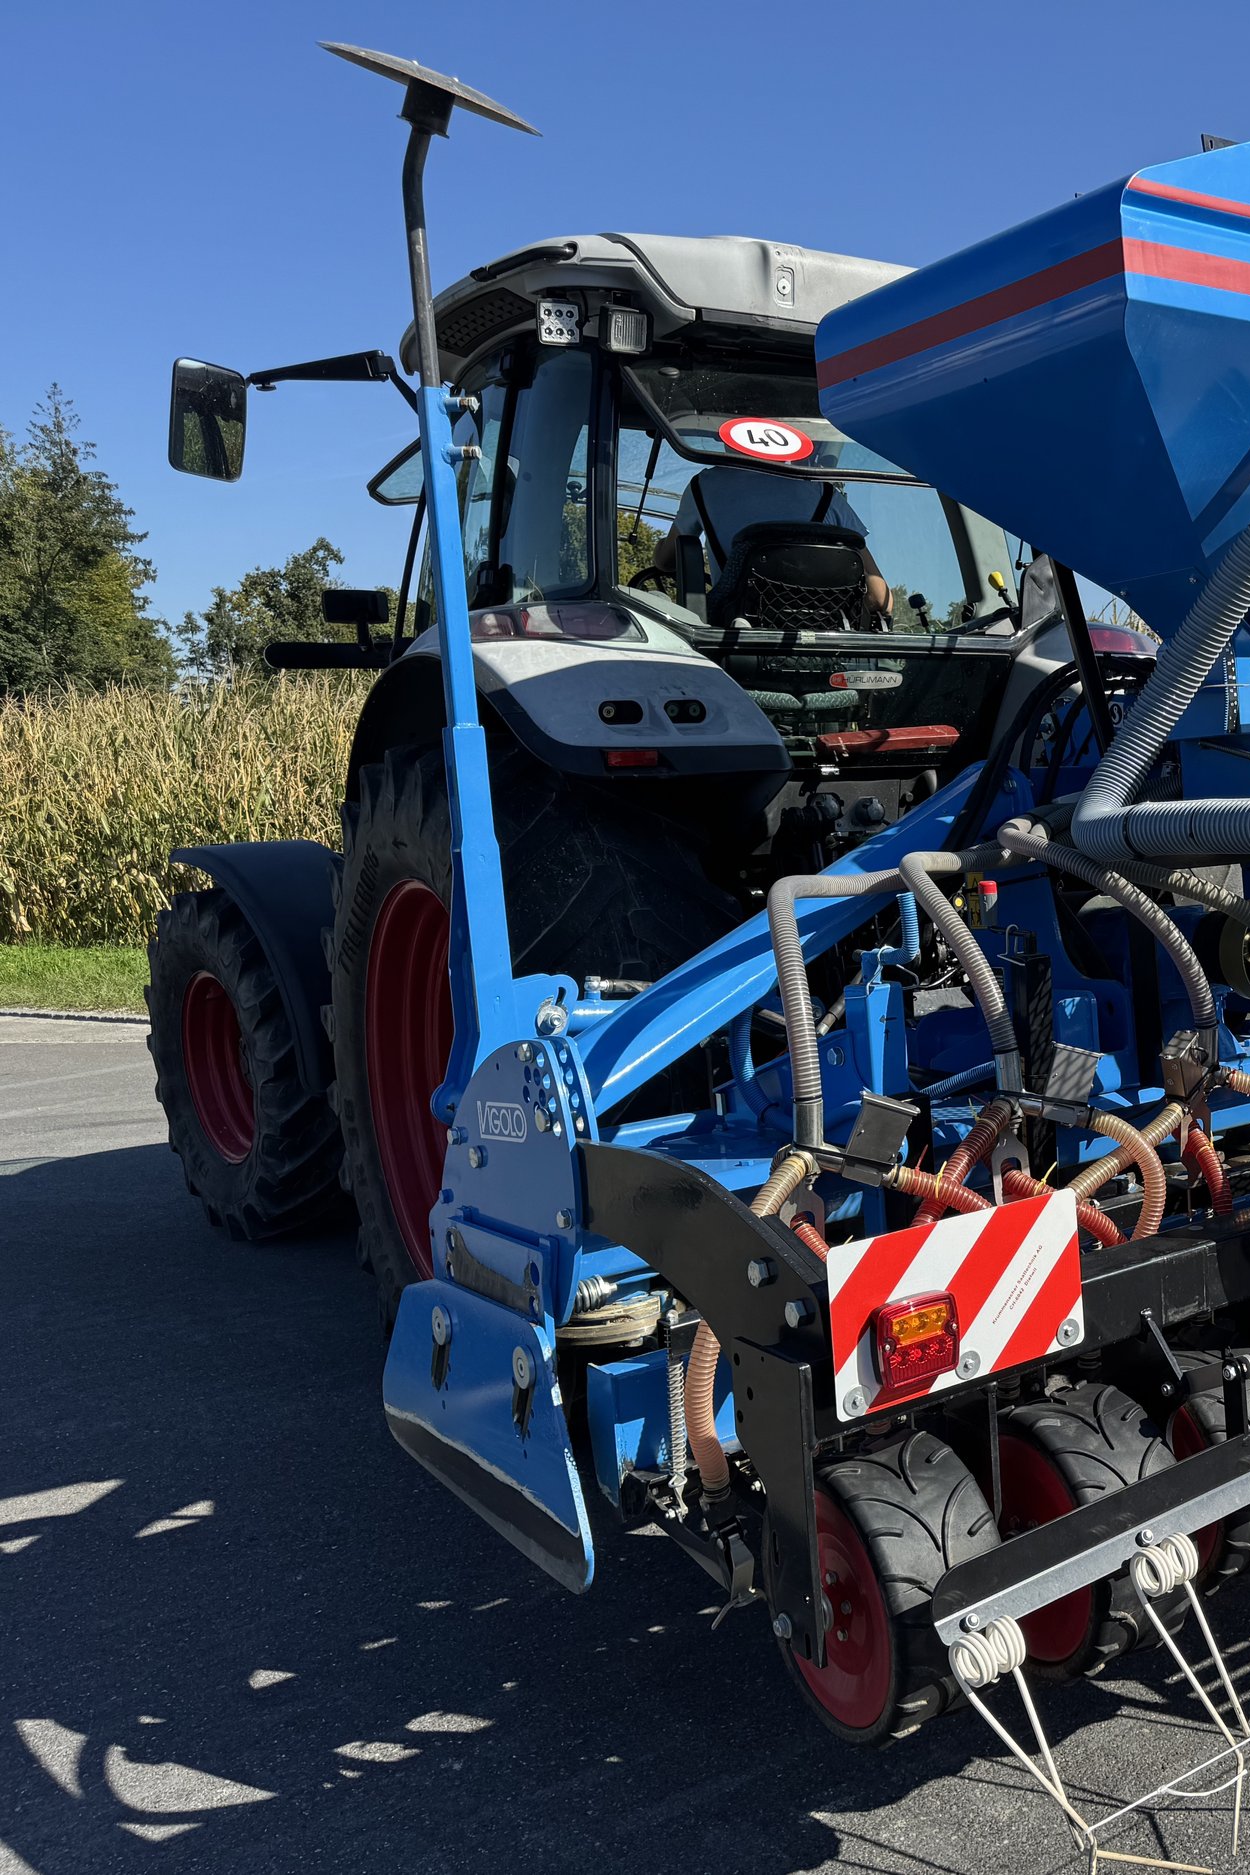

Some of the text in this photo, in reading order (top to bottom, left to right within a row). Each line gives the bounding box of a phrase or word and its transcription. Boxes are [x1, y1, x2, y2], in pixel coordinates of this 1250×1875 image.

[747, 428, 789, 447] 40
[338, 844, 379, 974] TRELLEBORG
[477, 1101, 525, 1138] VIGOLO
[1036, 1245, 1043, 1254] AG
